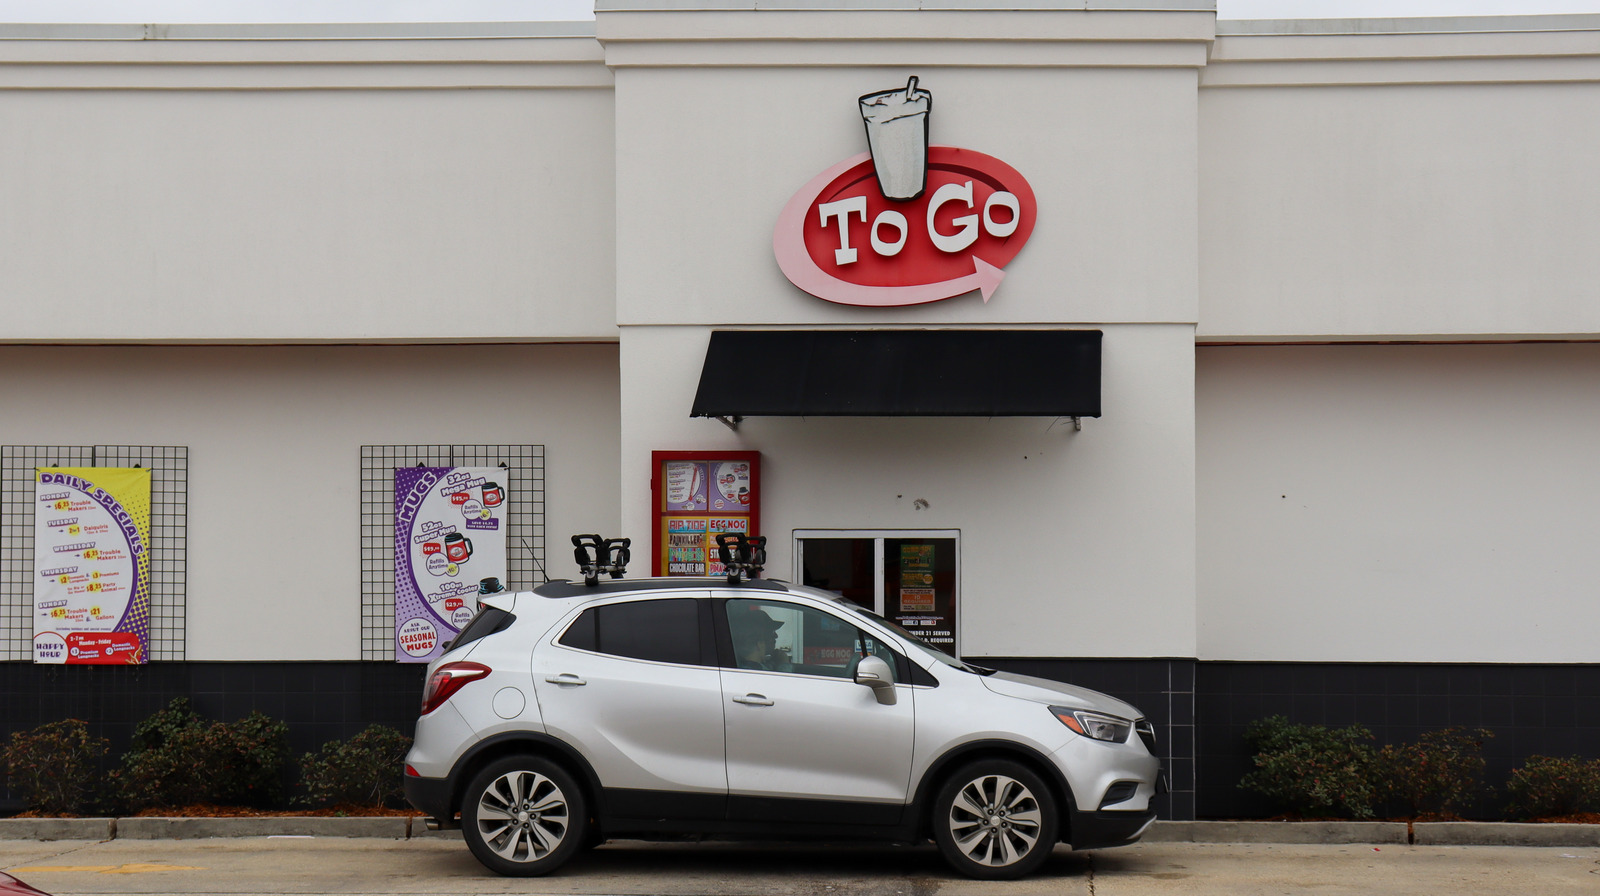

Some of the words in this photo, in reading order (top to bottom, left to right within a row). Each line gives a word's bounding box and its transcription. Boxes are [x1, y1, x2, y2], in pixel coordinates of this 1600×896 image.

[819, 196, 908, 265] To
[927, 181, 1020, 253] Go
[441, 485, 466, 497] Mega
[466, 477, 486, 488] Mug
[40, 492, 70, 501] MONDAY
[399, 472, 437, 522] MUGS
[40, 472, 93, 491] DAILY
[94, 488, 143, 555] SPECIALS
[47, 518, 78, 527] TUESDAY
[422, 521, 442, 532] 52oz
[669, 520, 684, 530] RIP
[686, 520, 705, 530] TIDE
[710, 520, 726, 528] EGG
[728, 520, 745, 528] NOG
[414, 532, 438, 544] Super
[438, 525, 456, 536] Mug
[670, 534, 700, 545] PAINKILLER
[53, 542, 96, 552] WEDNESDAY
[40, 566, 78, 576] THURSDAY
[670, 562, 694, 572] CHOCOLATE
[695, 562, 704, 572] BAR
[428, 591, 456, 603] Xtreme
[456, 584, 478, 594] Cooler
[38, 600, 68, 609] SUNDAY
[400, 632, 436, 644] SEASONAL
[407, 642, 433, 651] MUGS
[821, 649, 834, 658] EGG
[836, 649, 850, 658] NOG
